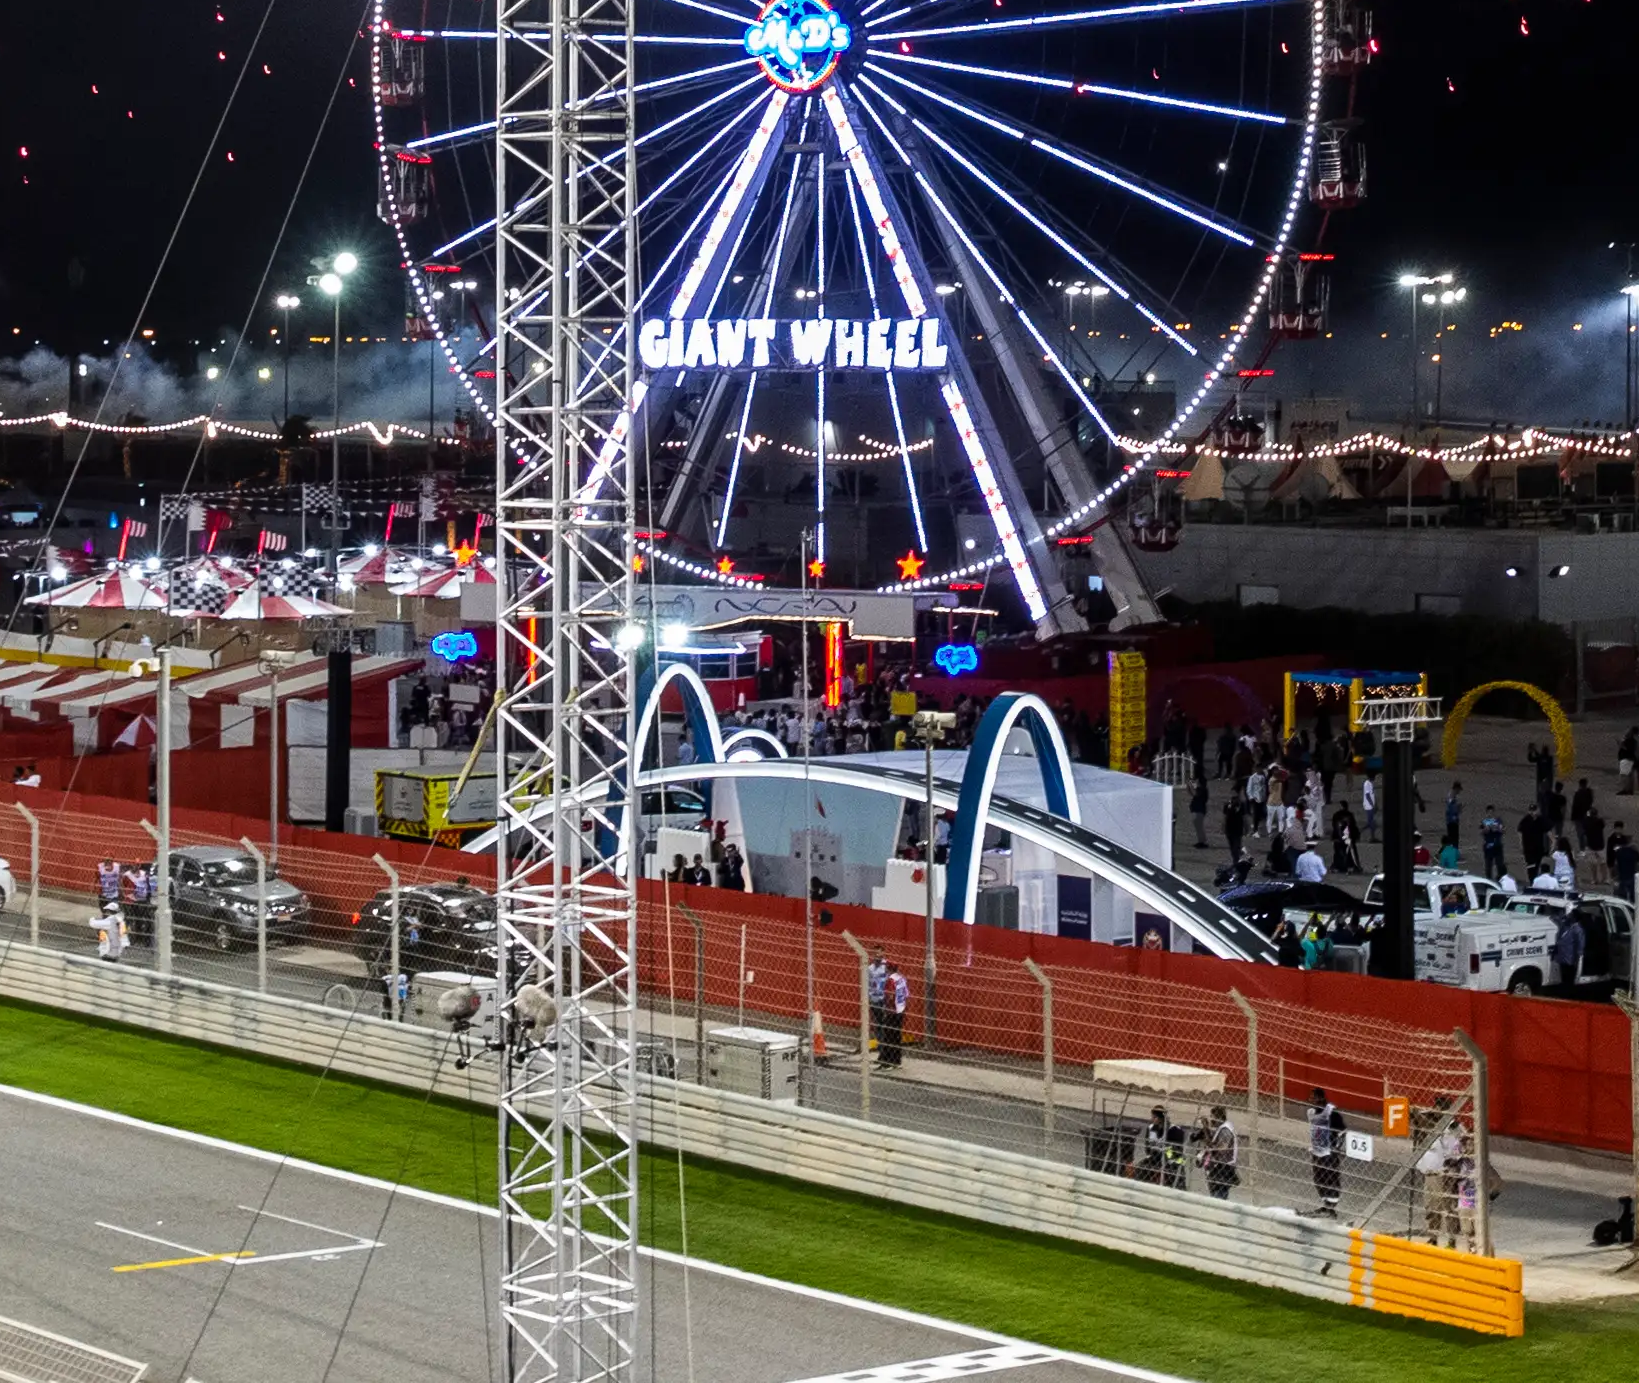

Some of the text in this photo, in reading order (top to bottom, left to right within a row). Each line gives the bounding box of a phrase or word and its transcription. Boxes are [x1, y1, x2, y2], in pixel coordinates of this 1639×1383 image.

[638, 317, 949, 368] GIANT WHEEL
[1506, 946, 1543, 957] CRIME SCENE
[1388, 1104, 1405, 1129] F
